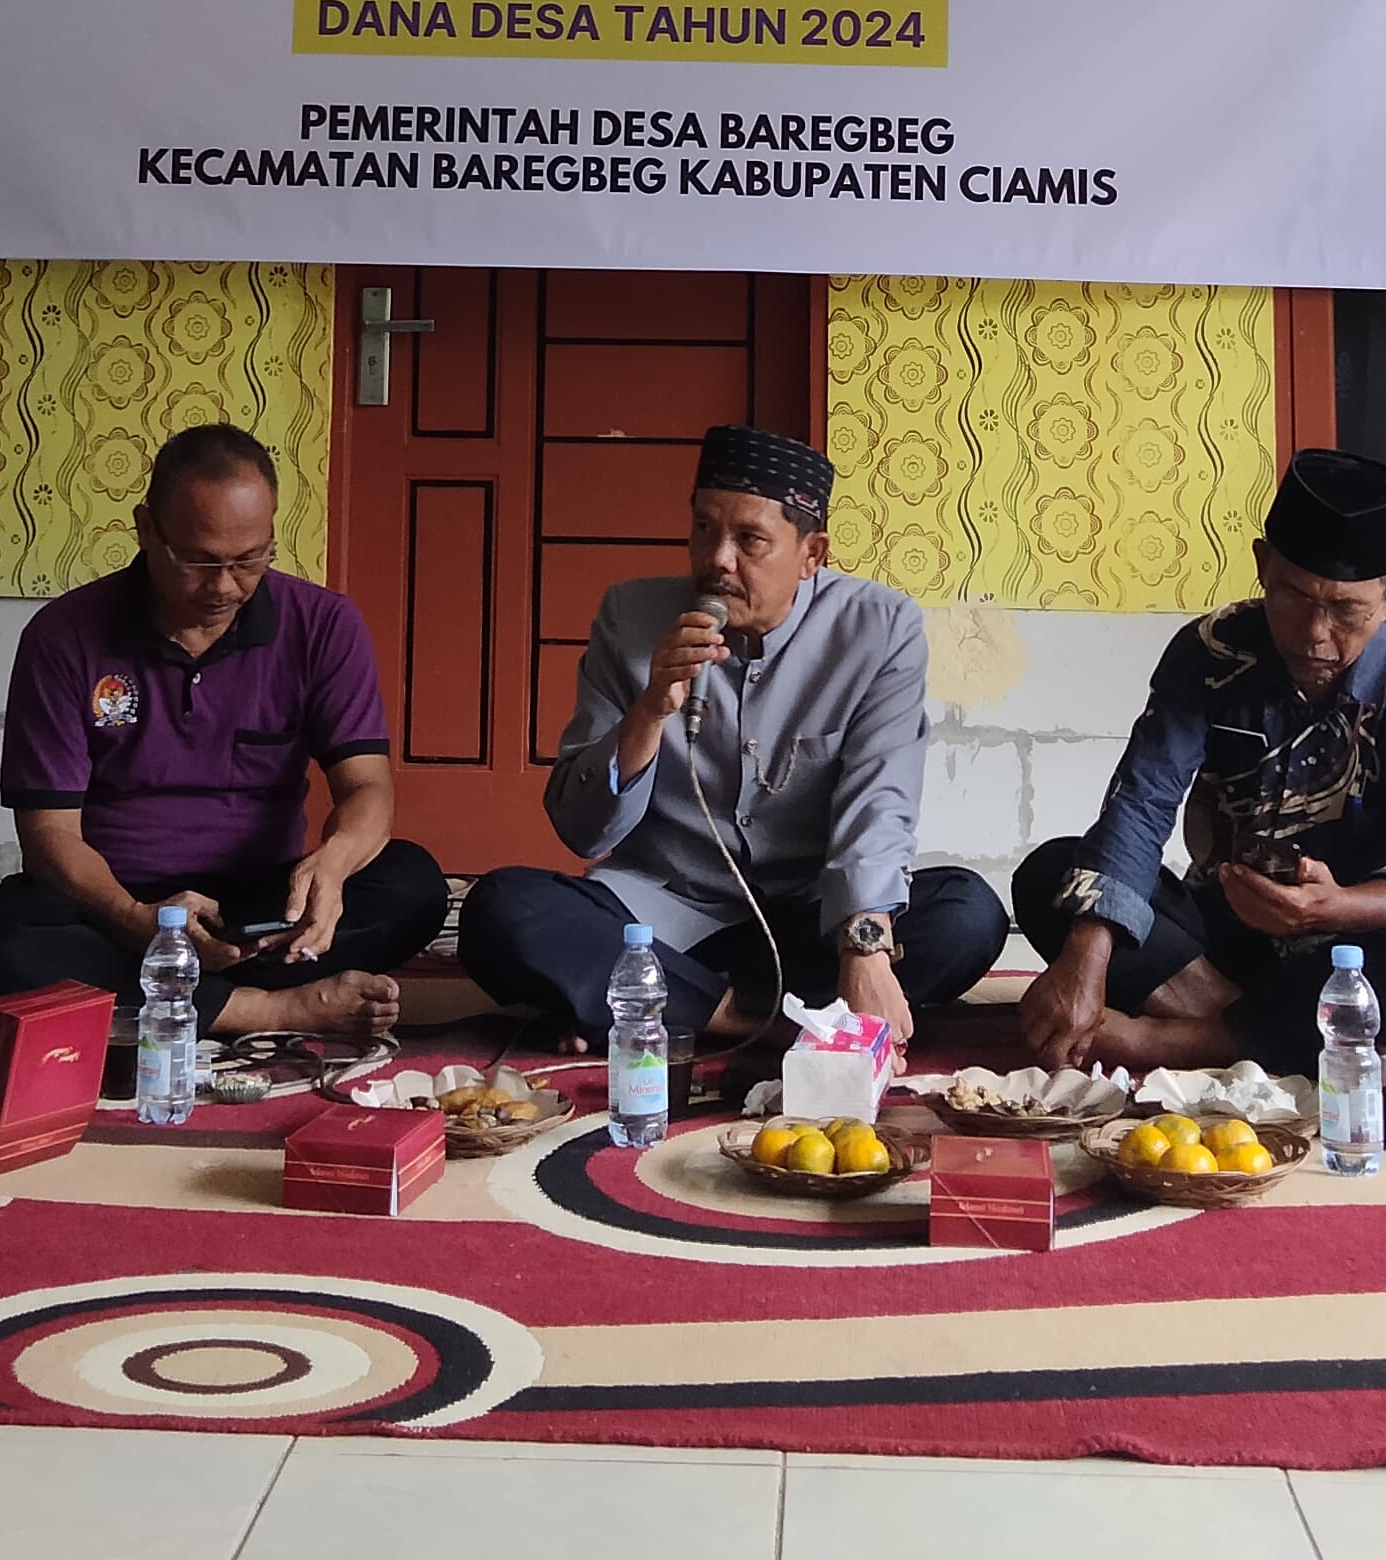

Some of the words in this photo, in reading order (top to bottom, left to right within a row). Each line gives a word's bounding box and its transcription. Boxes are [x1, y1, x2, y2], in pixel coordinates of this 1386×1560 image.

[318, 0, 456, 38] DANA
[471, 2, 601, 41] DESA
[614, 5, 786, 45] TAHUN
[801, 9, 926, 49] 2024
[301, 104, 579, 144] PEMERINTAH
[593, 110, 708, 149] DESA
[720, 113, 955, 155] BAREGBEG
[138, 148, 419, 189] KECAMATAN
[432, 153, 667, 195] BAREGBEG
[679, 158, 946, 202] KABUPATEN
[959, 165, 1118, 206] CIAMIS
